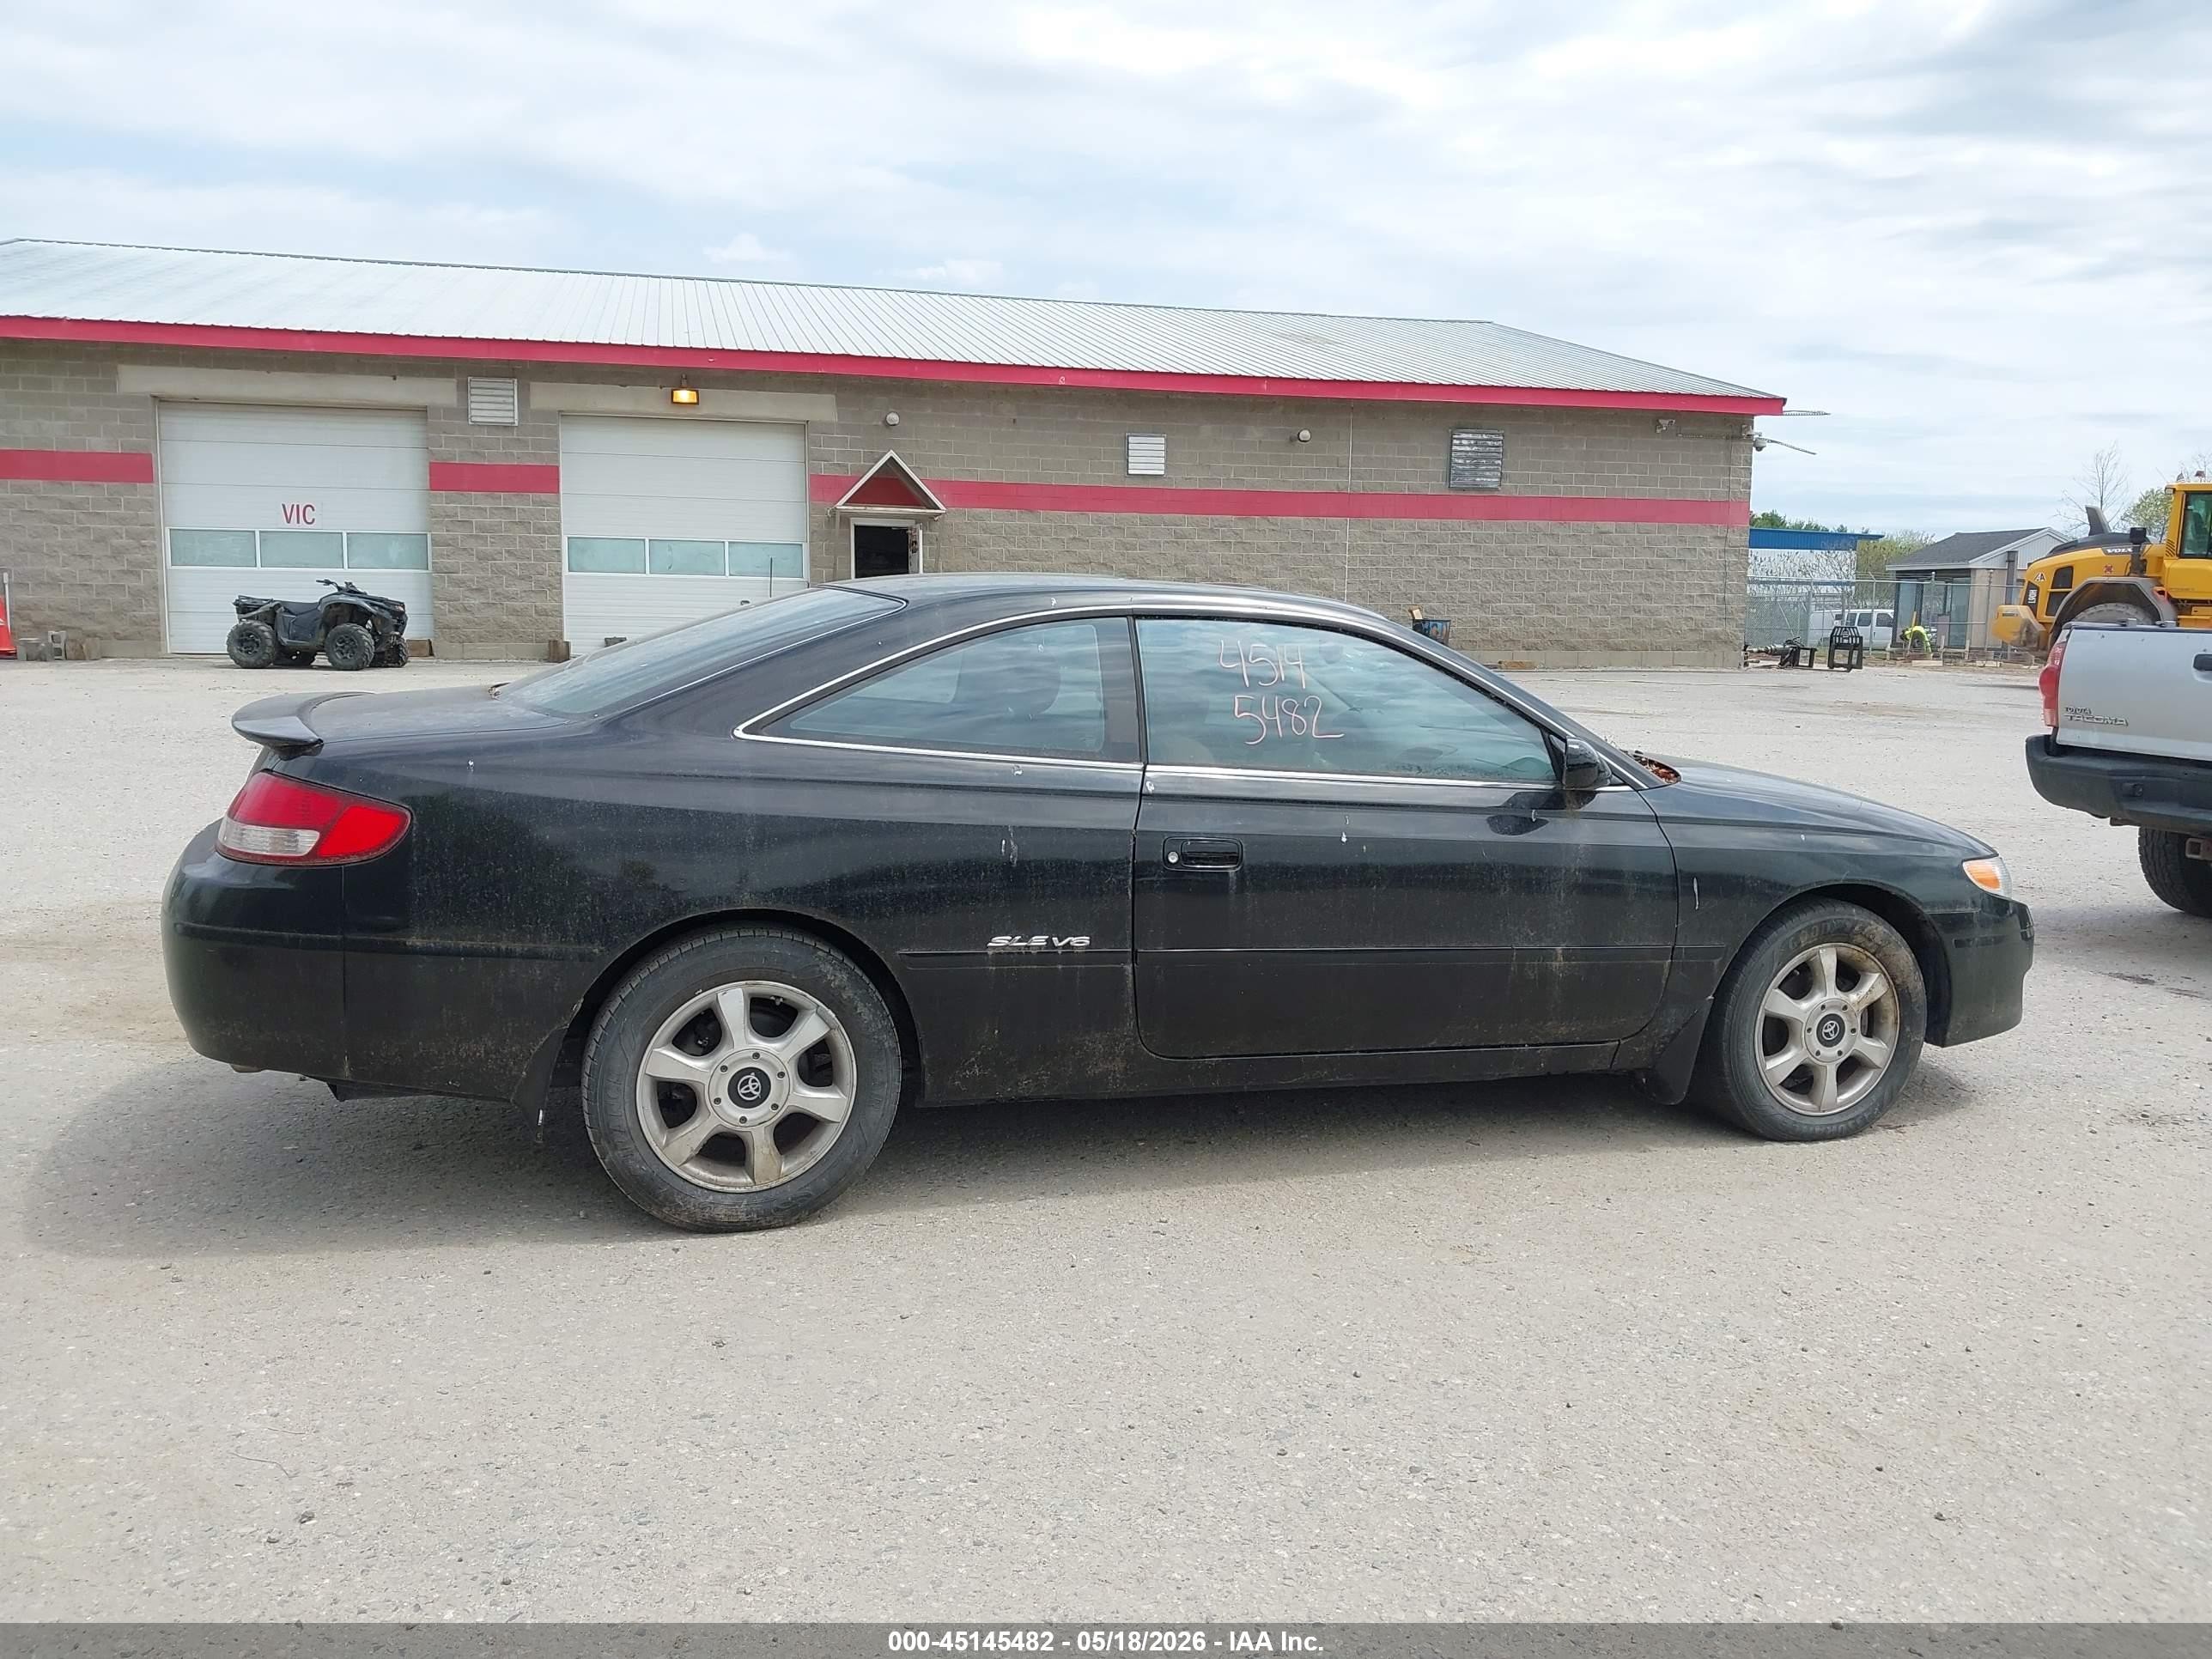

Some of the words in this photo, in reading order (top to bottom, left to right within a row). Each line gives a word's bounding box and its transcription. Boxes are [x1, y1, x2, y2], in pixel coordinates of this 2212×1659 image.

[281, 503, 316, 525] VIC
[1219, 640, 1306, 689] 4514
[1233, 695, 1345, 744] 5482
[2063, 714, 2129, 726] TACOMA
[987, 935, 1049, 947] SLE
[1052, 936, 1091, 947] V6
